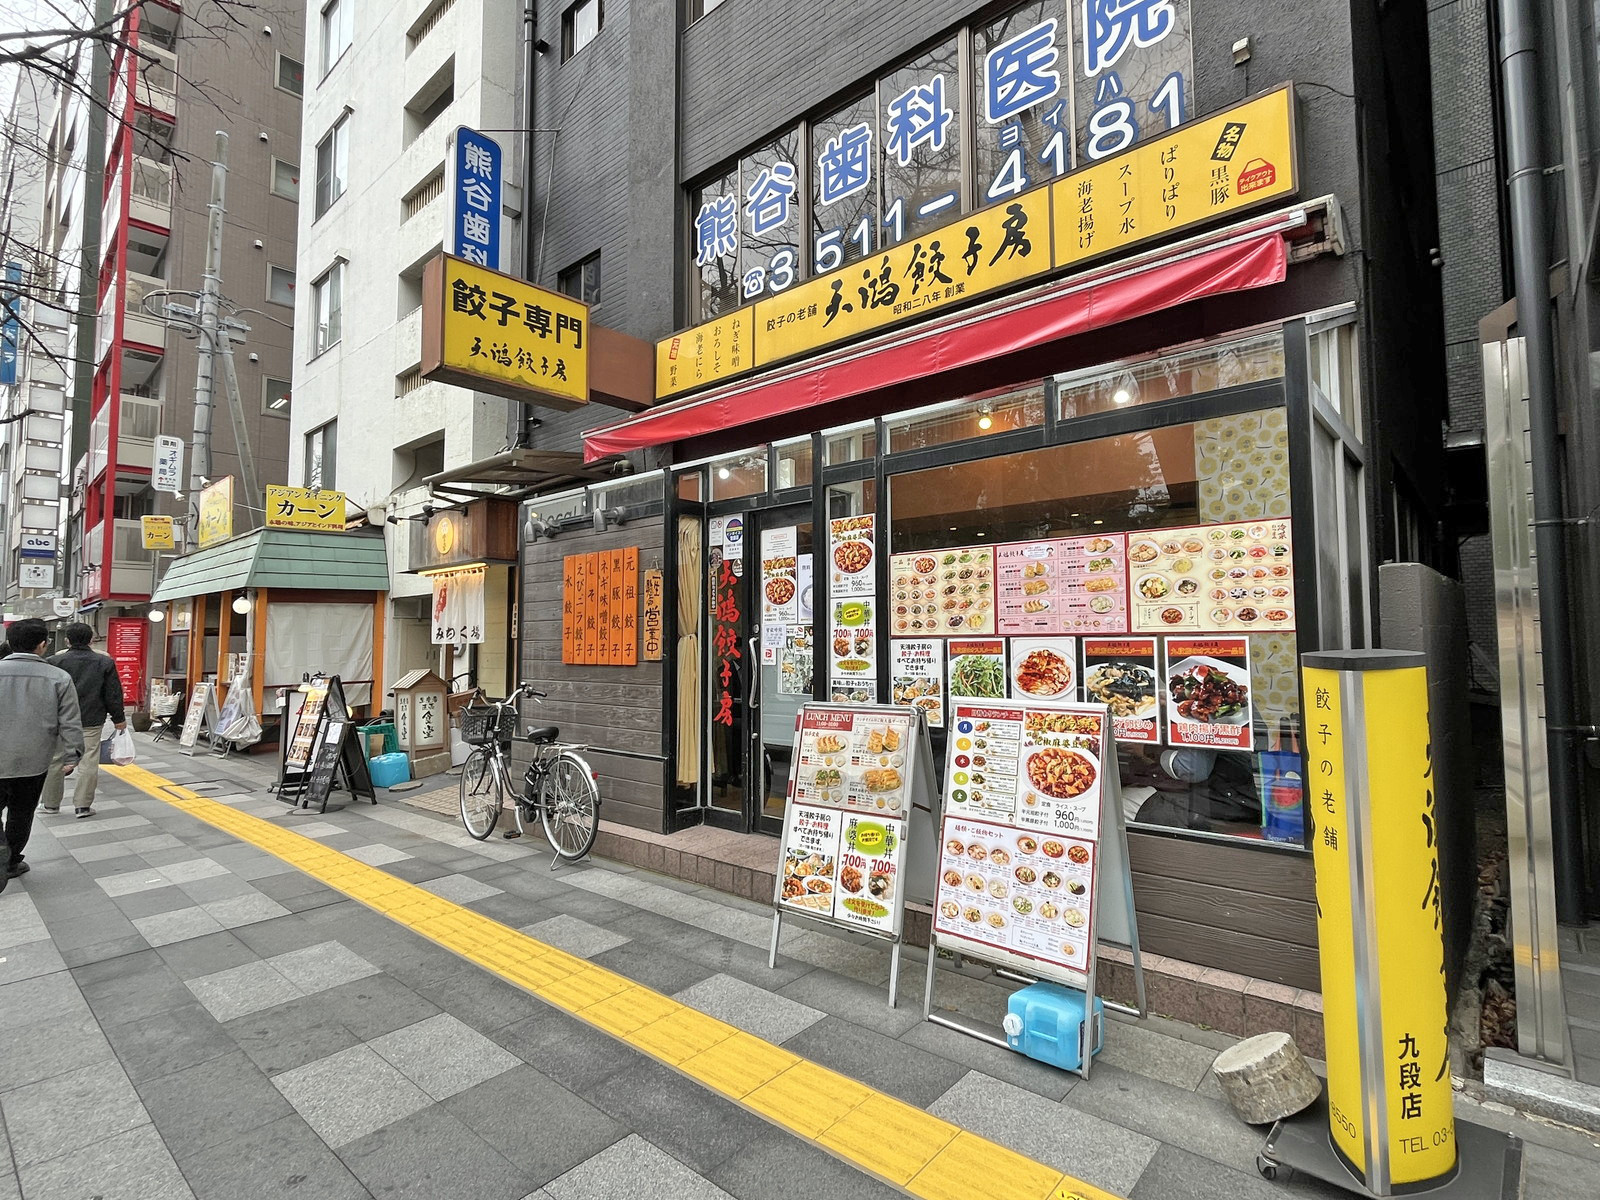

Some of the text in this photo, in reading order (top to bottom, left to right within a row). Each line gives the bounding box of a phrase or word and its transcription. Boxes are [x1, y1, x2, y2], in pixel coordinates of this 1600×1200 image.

[695, 0, 1175, 267] 熊谷歯科医院
[1216, 124, 1241, 160] 名物
[1117, 163, 1136, 236] スープ水
[1161, 144, 1179, 222] ぱりぱり
[1210, 165, 1230, 207] 黒豚
[1240, 176, 1272, 193] 出来ます
[1077, 179, 1096, 250] 海老揚げ
[823, 202, 1033, 328] 天鴻餃子房
[451, 278, 583, 350] 餃子専門
[766, 304, 818, 332] 餃子の老舗
[893, 282, 966, 315] 昭和二八年 創業
[469, 336, 568, 382] 天鴻餃子房
[695, 332, 704, 379] 海老にら
[713, 326, 722, 373] おろしそ
[731, 319, 741, 368] ねぎ味噌
[669, 364, 678, 387] 野菜
[168, 450, 178, 477] オギムラ
[269, 488, 302, 499] アジアン
[277, 500, 336, 518] カーン
[27, 538, 50, 546] abc
[147, 531, 171, 540] カーン
[586, 561, 596, 657] しそ餃子
[598, 560, 609, 657] ネギ味噌餃子
[611, 558, 621, 658] 黒豚餃子
[625, 556, 635, 658] 元祖餃子
[806, 711, 853, 723] LUNCH MENU
[1315, 686, 1339, 851] 餃子の老舗
[1397, 1032, 1423, 1121] 九段店
[1399, 1136, 1429, 1154] TEL
